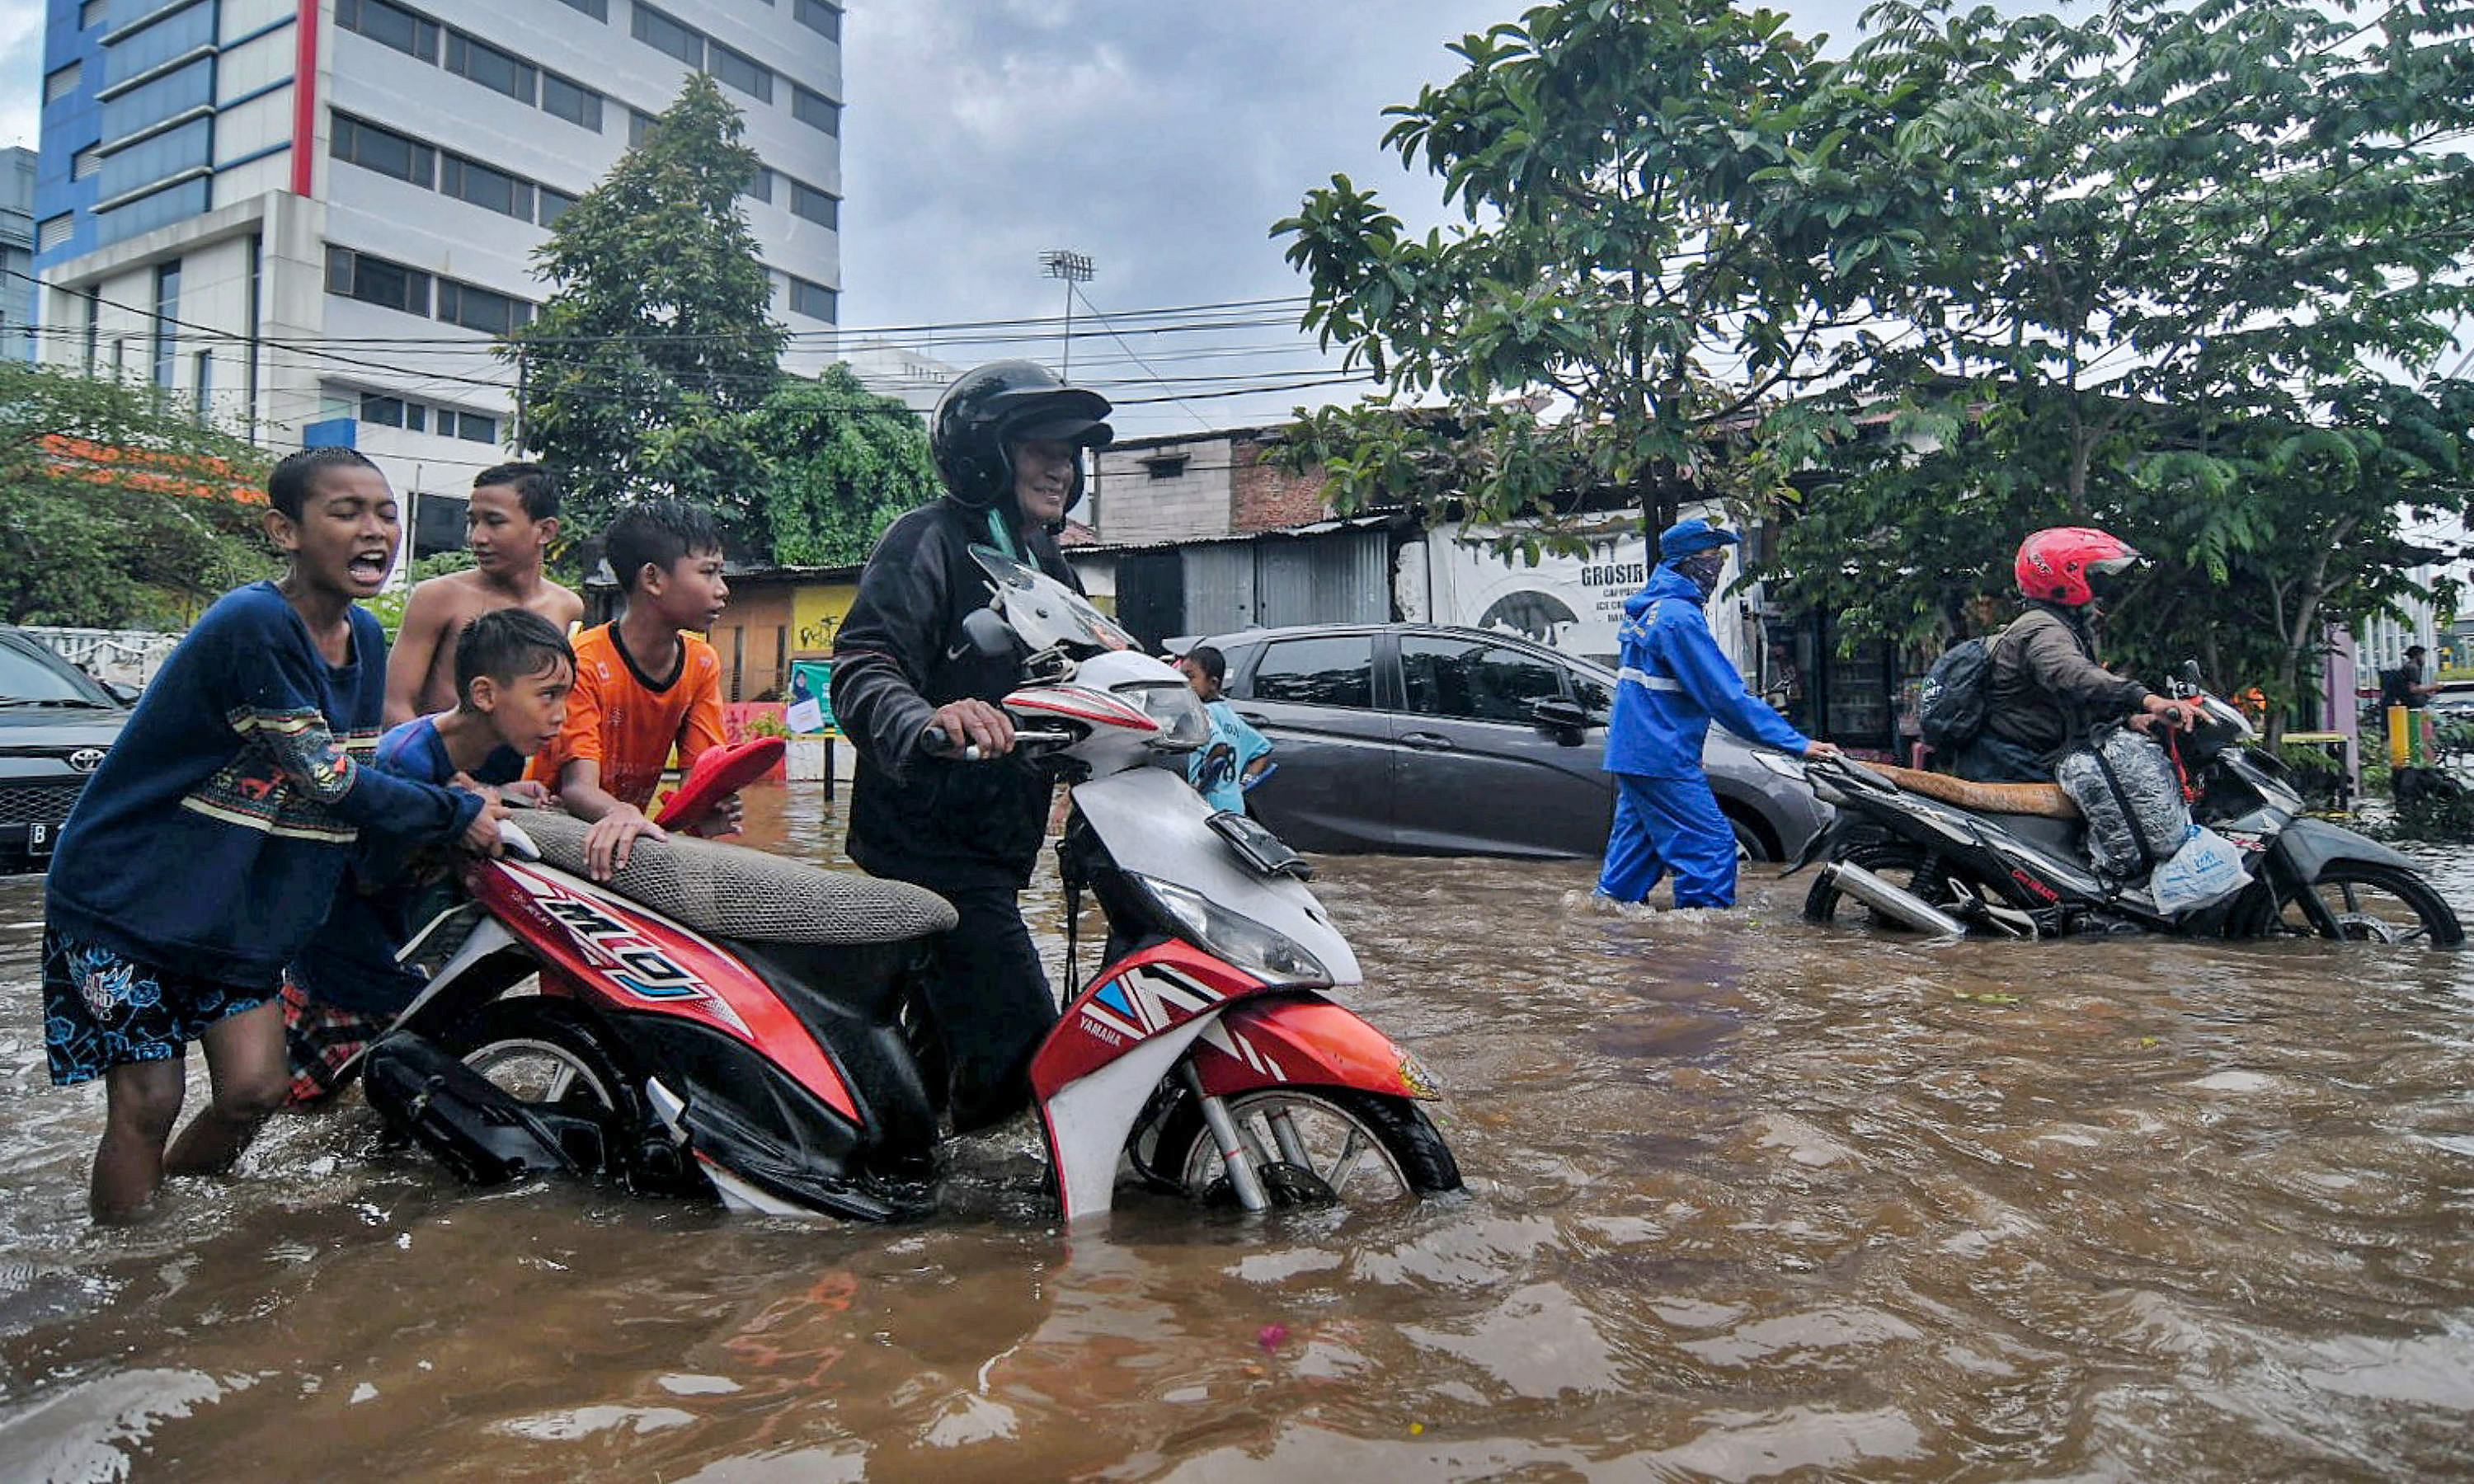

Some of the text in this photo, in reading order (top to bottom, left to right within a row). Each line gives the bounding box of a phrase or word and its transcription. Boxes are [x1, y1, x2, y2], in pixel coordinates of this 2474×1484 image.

[1582, 563, 1643, 586] GROSIR
[34, 825, 46, 843] B
[1079, 1015, 1122, 1047] YAMAHA
